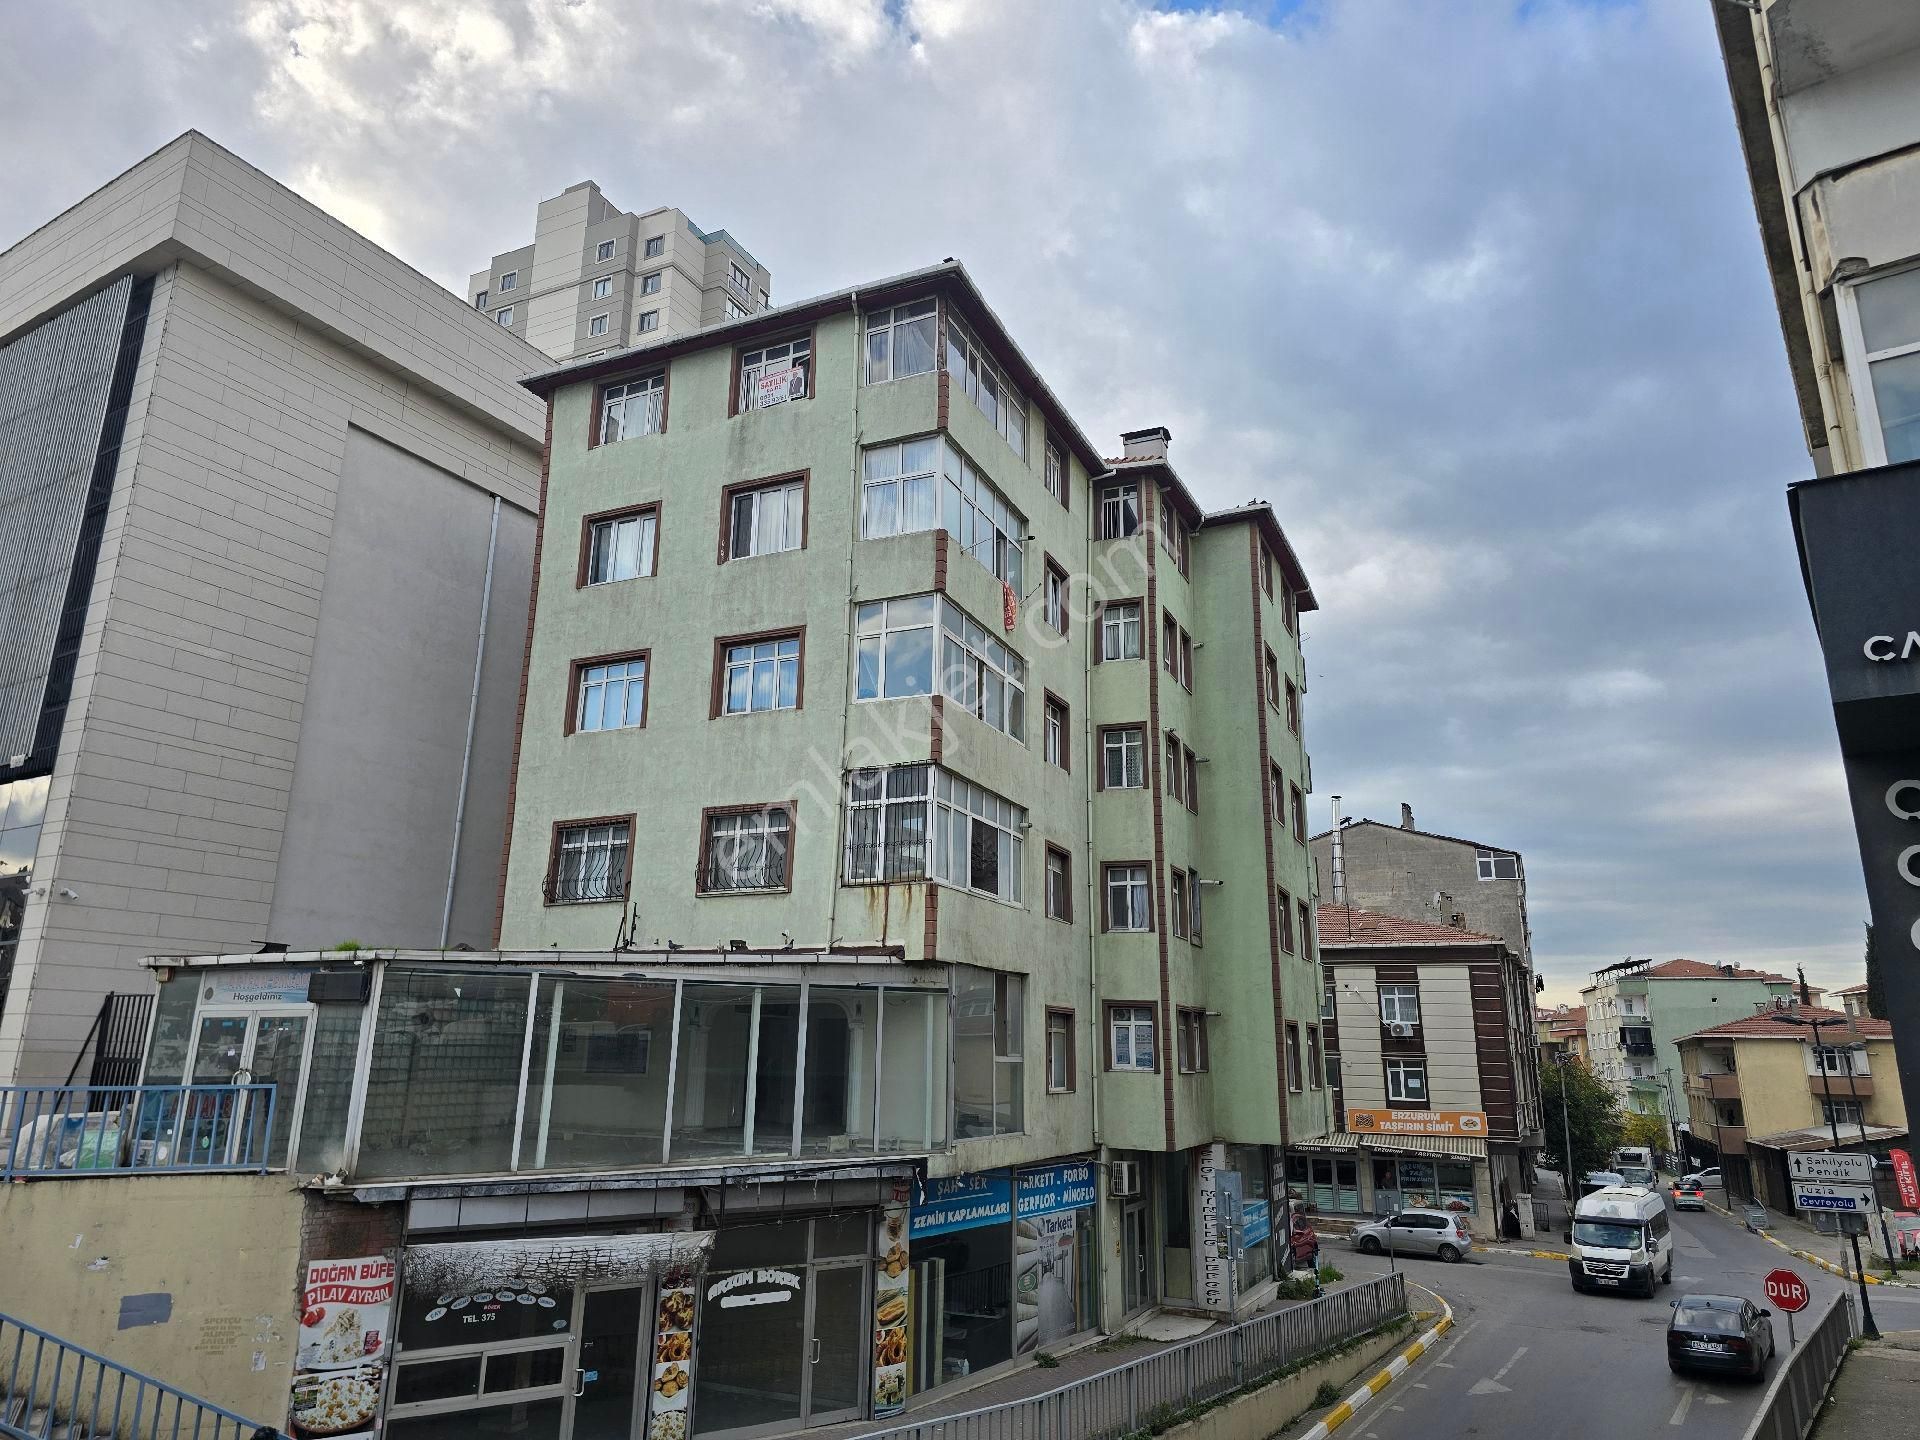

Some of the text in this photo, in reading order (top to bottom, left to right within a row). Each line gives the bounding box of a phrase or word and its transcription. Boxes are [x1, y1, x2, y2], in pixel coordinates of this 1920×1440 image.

[760, 376, 787, 390] SATILIK
[1391, 1111, 1440, 1120] ERZURUM
[1380, 1120, 1454, 1132] TAŞFIRIN SİMİT
[1806, 1156, 1862, 1168] Sahilyolu
[1063, 1167, 1089, 1184] FORBO
[1808, 1166, 1850, 1177] Pendik
[1018, 1190, 1056, 1212] GERFLOR
[1801, 1196, 1855, 1208] Çevreyolu
[913, 1201, 1010, 1229] ZEMİN KAPLAMALARI
[1045, 1214, 1072, 1235] Tarkett
[310, 1260, 395, 1284] DOĞAN BÜFE
[307, 1286, 389, 1305] PİLAV AYRAN
[1767, 1280, 1803, 1300] DUR
[481, 1312, 496, 1322] 375
